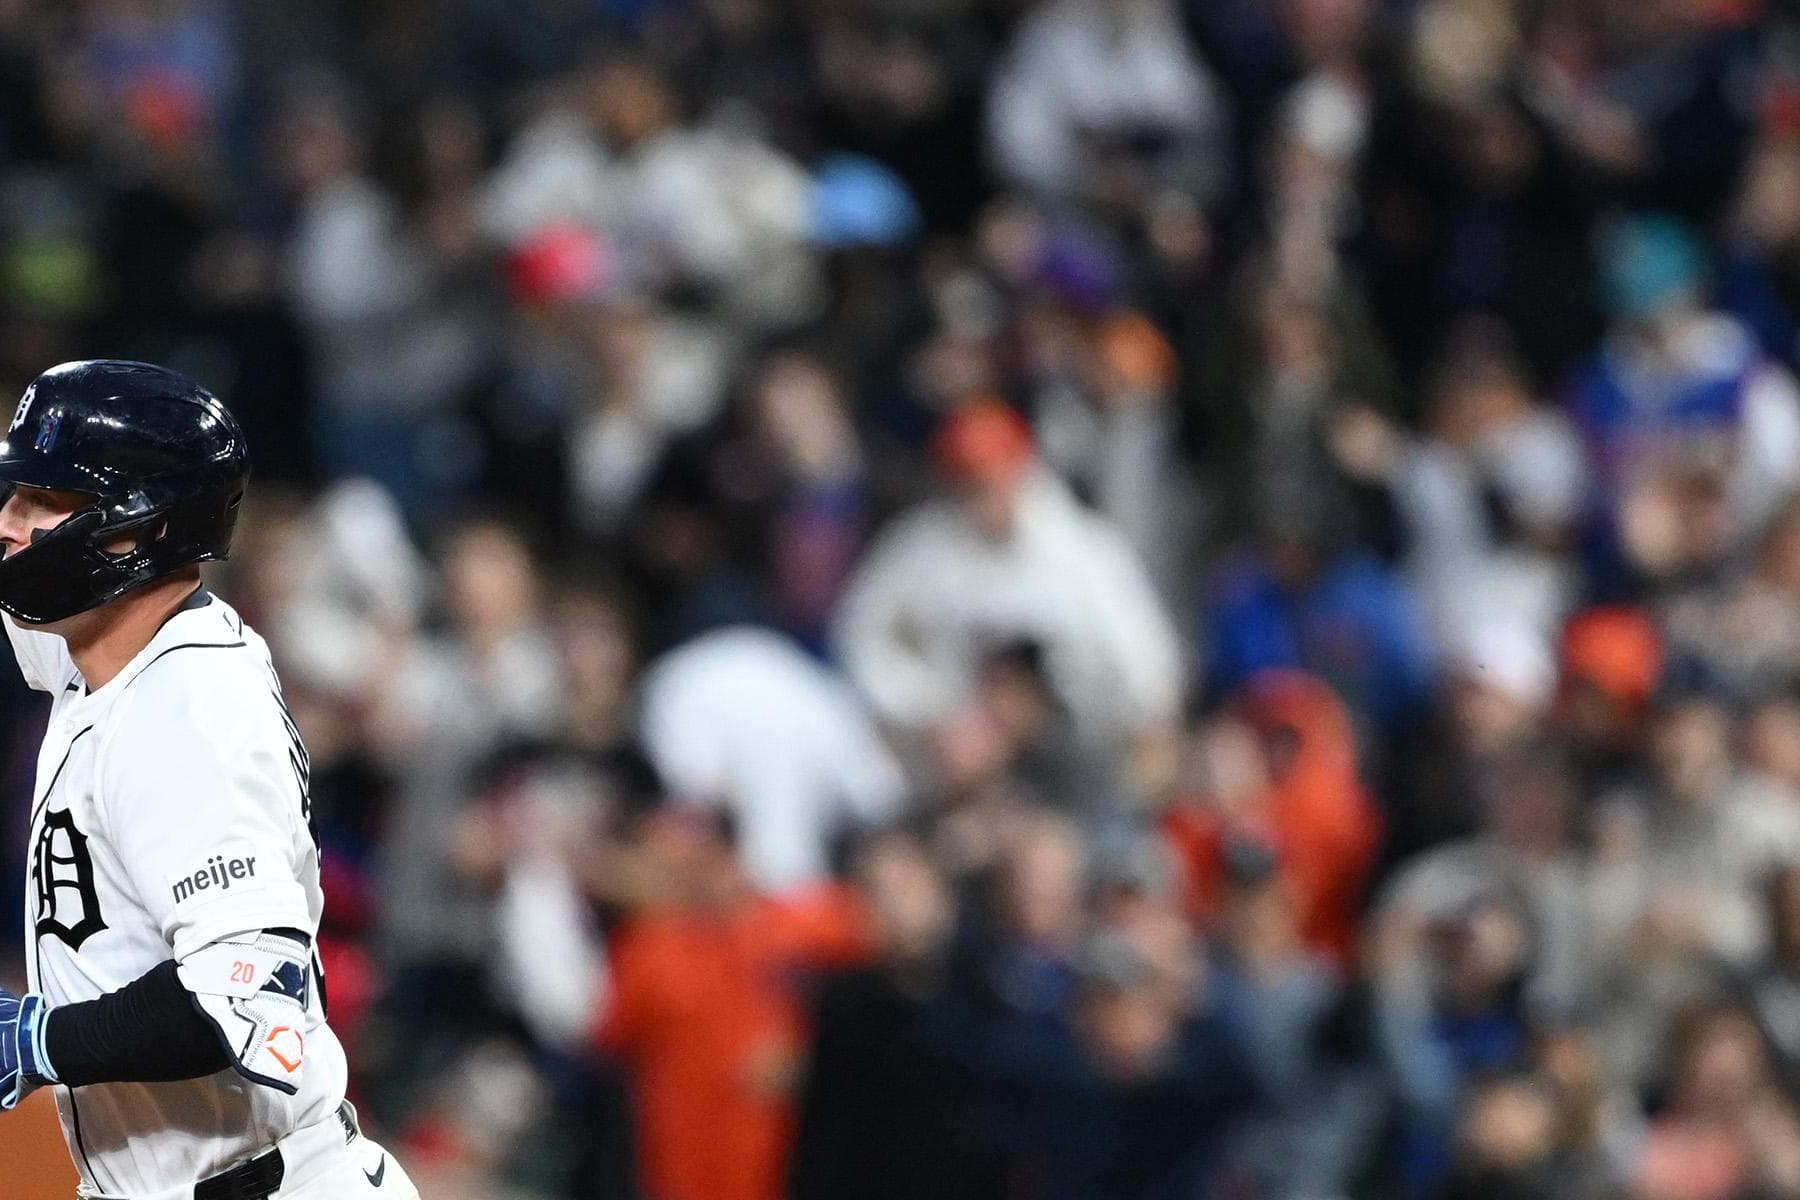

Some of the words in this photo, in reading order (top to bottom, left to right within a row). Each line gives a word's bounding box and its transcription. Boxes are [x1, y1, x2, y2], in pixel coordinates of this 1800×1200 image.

[32, 807, 109, 953] D
[171, 854, 257, 904] meijer
[230, 960, 255, 985] 20
